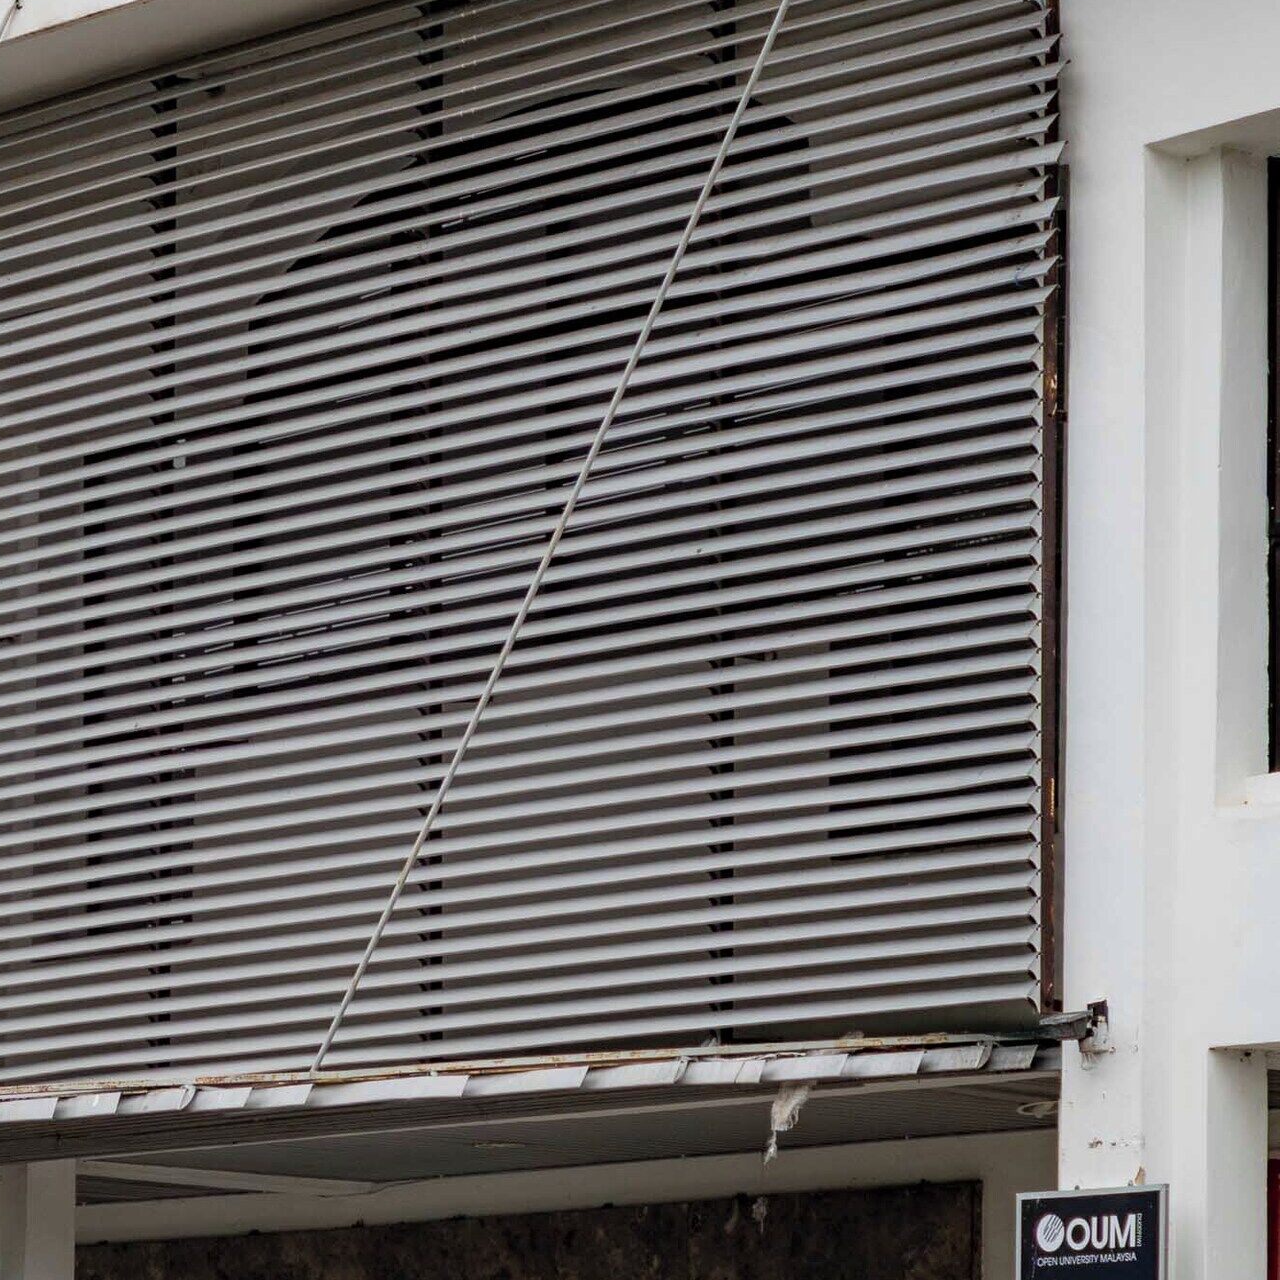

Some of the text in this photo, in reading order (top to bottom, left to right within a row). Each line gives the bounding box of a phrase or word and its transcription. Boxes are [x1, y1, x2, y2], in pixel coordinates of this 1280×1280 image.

[1066, 1213, 1136, 1251] OUM
[1037, 1251, 1137, 1267] OPEN UNIVERSITY MALAYSIA
